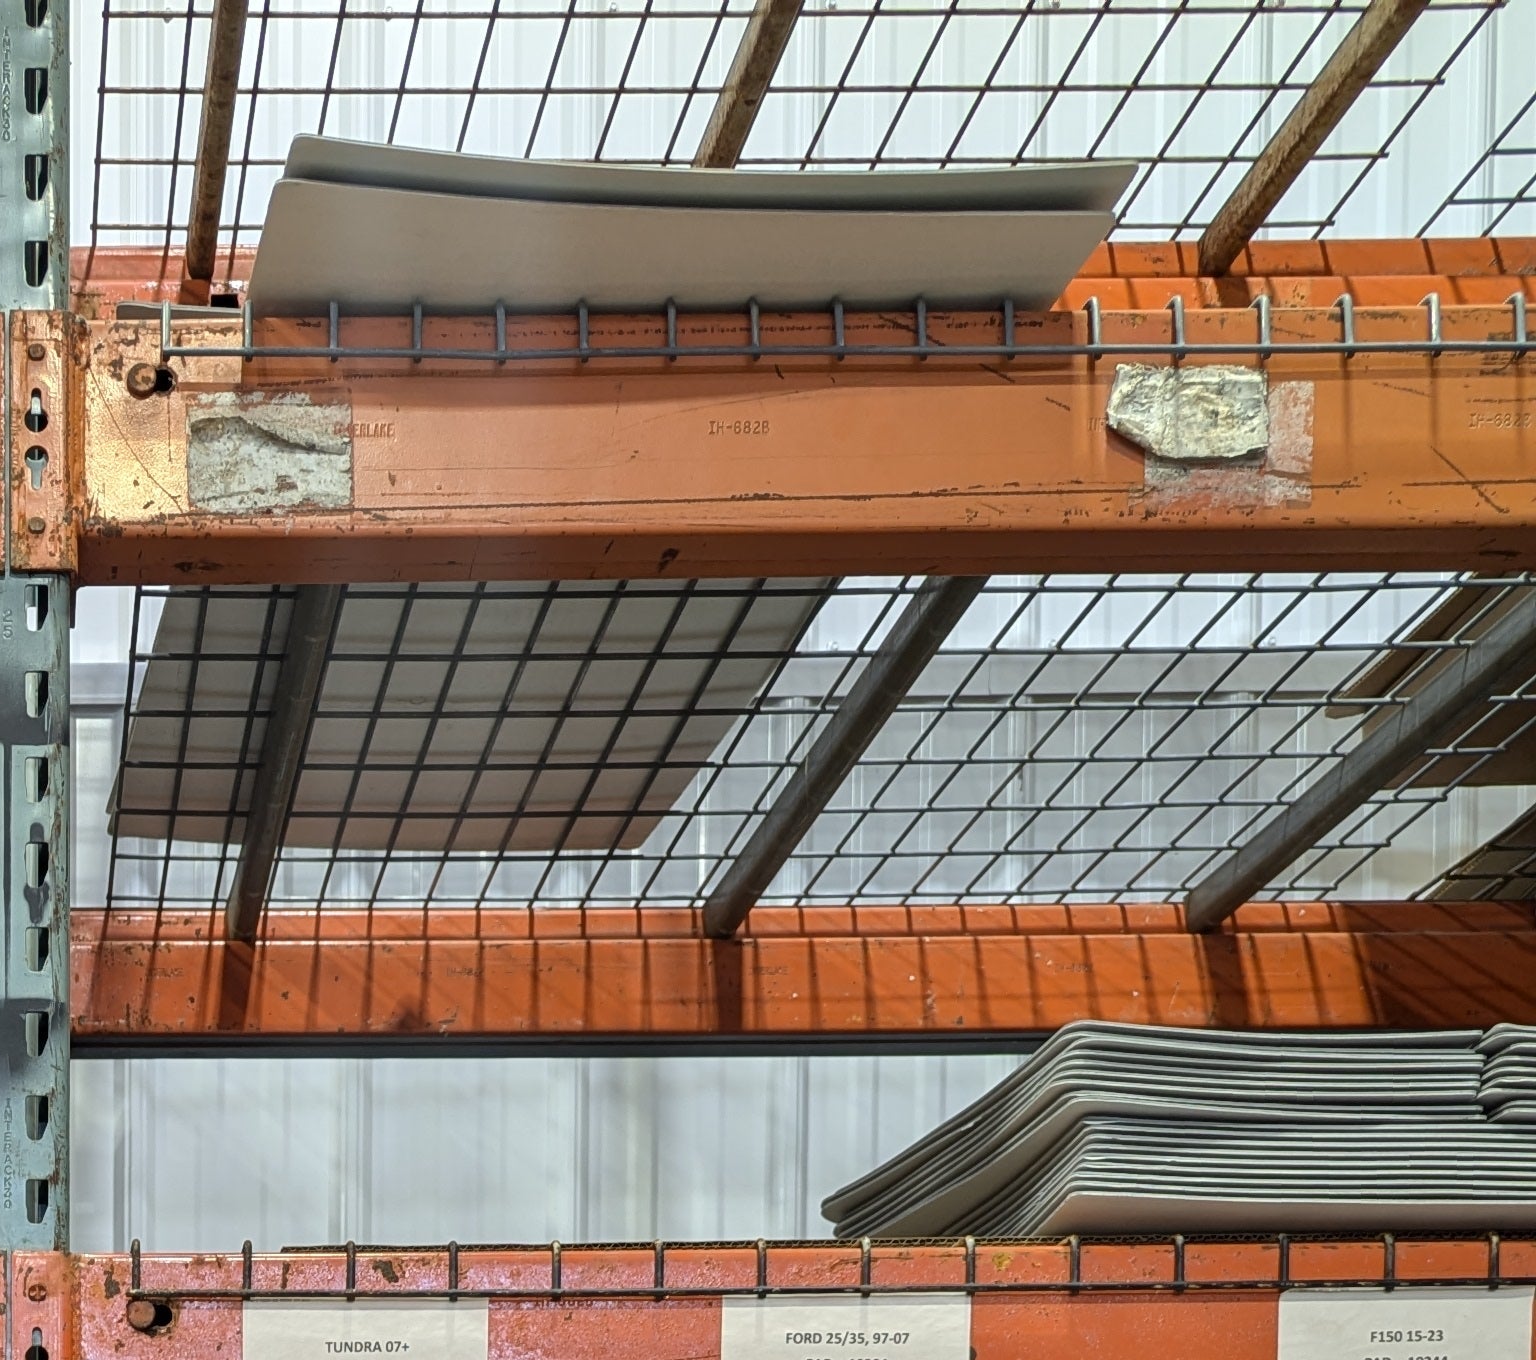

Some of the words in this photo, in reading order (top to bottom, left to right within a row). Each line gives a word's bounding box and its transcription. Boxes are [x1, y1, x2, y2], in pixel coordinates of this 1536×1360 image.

[785, 1332, 822, 1344] FORD
[826, 1331, 869, 1346] 25/35,
[873, 1332, 910, 1344] 97-07
[1370, 1331, 1403, 1342] F150
[1406, 1330, 1444, 1342] 15-23
[325, 1341, 382, 1353] TUNDRA
[386, 1341, 410, 1353] 07+
